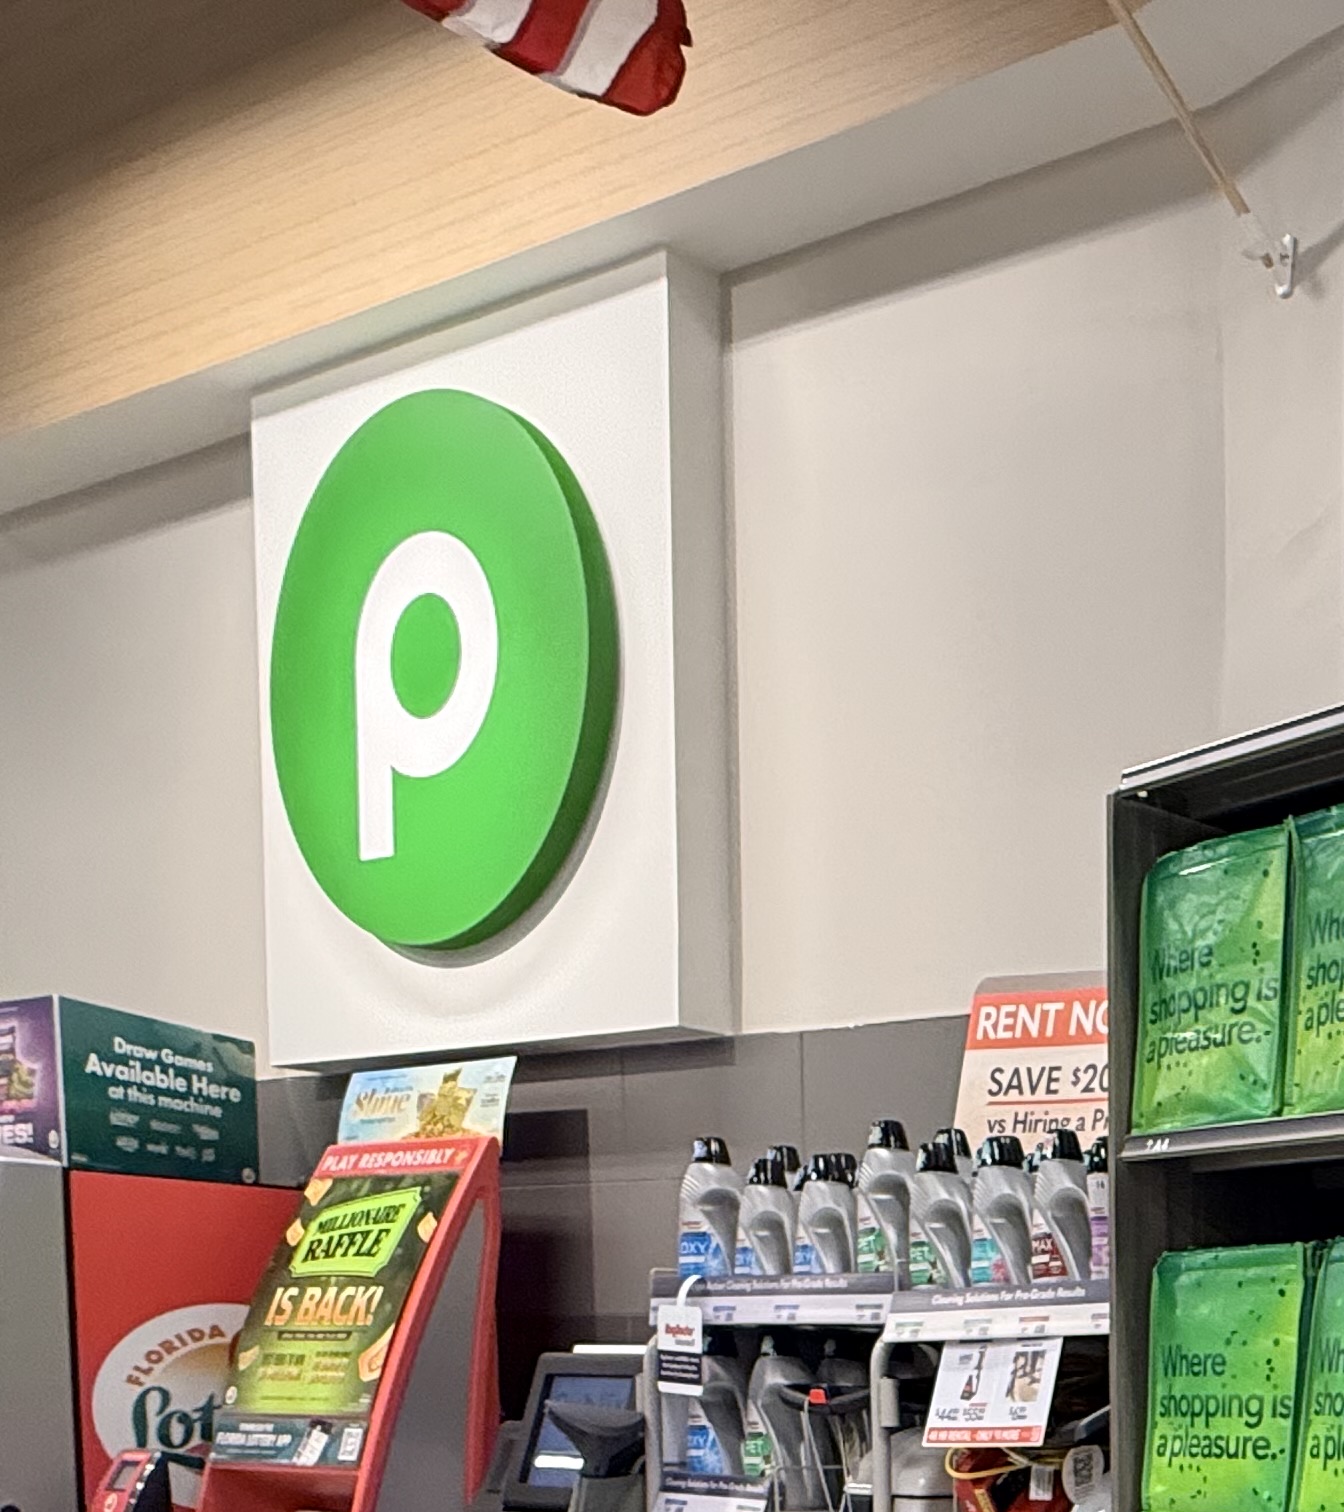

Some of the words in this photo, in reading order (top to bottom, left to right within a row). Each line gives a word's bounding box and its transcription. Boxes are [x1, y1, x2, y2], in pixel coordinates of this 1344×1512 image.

[976, 1002, 1065, 1040] RENT
[113, 1035, 159, 1061] Draw
[160, 1048, 213, 1073] Games
[85, 1052, 188, 1092] Available
[191, 1074, 242, 1103] Here
[987, 1065, 1062, 1097] SAVE
[108, 1086, 124, 1100] at
[127, 1085, 155, 1106] this
[158, 1095, 223, 1118] machine
[987, 1118, 1006, 1134] vs
[1075, 1116, 1086, 1132] a
[321, 1154, 356, 1171] PLAY
[358, 1147, 455, 1169] RESPONSIBLY
[316, 1203, 406, 1235] MILLIONAIRE
[301, 1228, 391, 1263] RAFFLE
[681, 1242, 708, 1254] OXY
[264, 1286, 300, 1326] IS
[296, 1285, 384, 1326] BACK!
[125, 1325, 225, 1387] FLORIDA
[1162, 1345, 1226, 1378] Where
[1159, 1385, 1264, 1429] shopping
[1271, 1392, 1292, 1420] is
[1156, 1434, 1167, 1457] a
[1168, 1427, 1277, 1467] pleasure.
